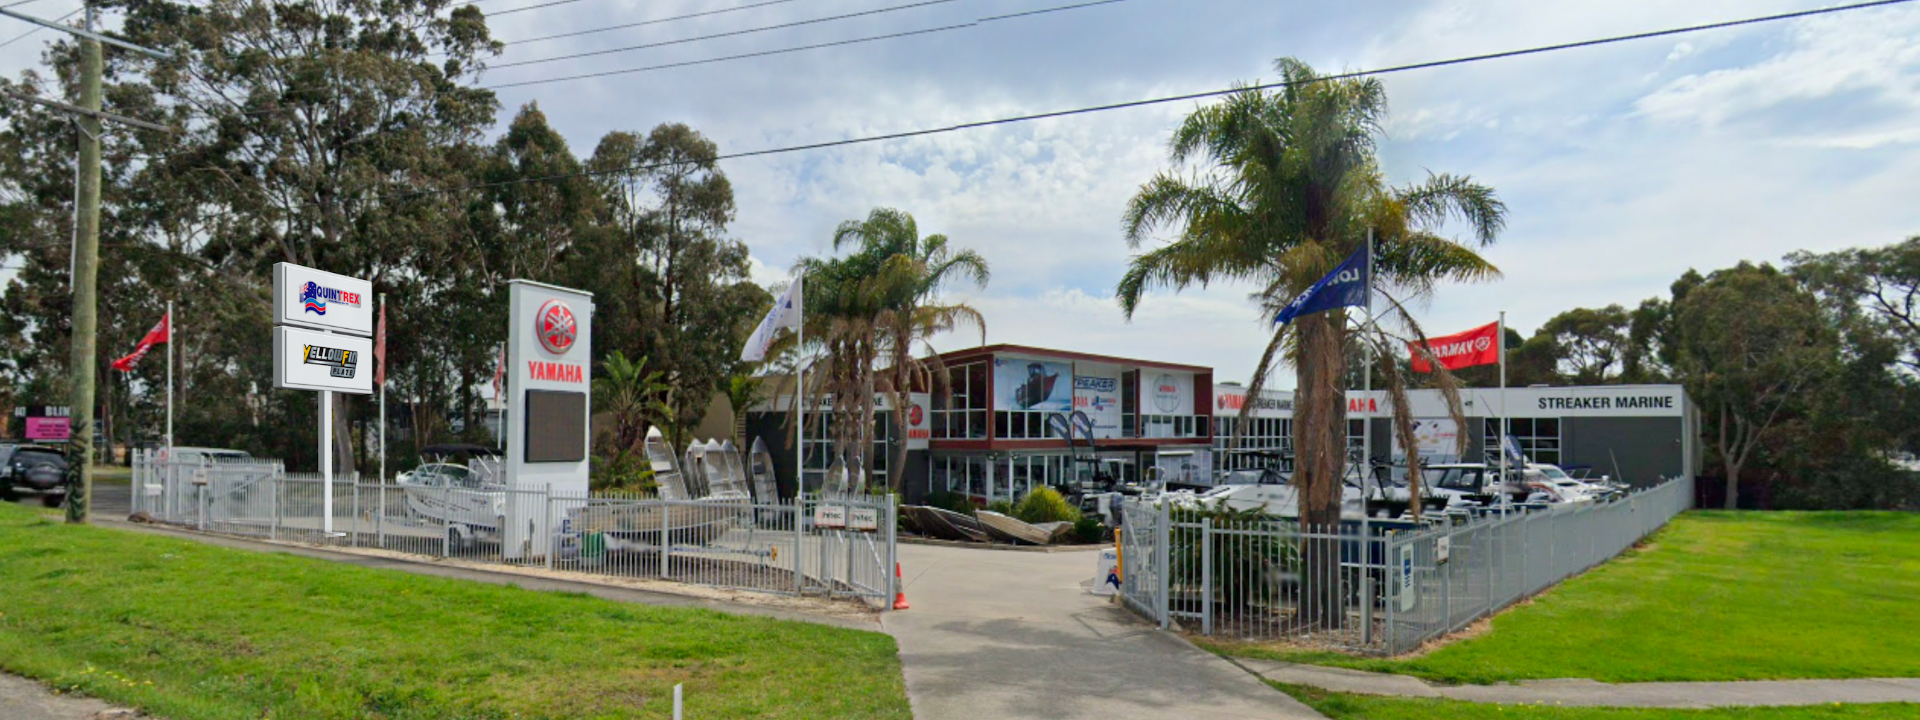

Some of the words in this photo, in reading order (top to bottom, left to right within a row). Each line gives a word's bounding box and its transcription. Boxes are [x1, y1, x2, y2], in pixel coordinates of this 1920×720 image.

[316, 285, 361, 306] QUINTREX
[332, 366, 354, 377] PLATE
[528, 361, 583, 383] YAMAHA
[1538, 397, 1611, 409] STREAKER
[1615, 396, 1673, 408] MARINE
